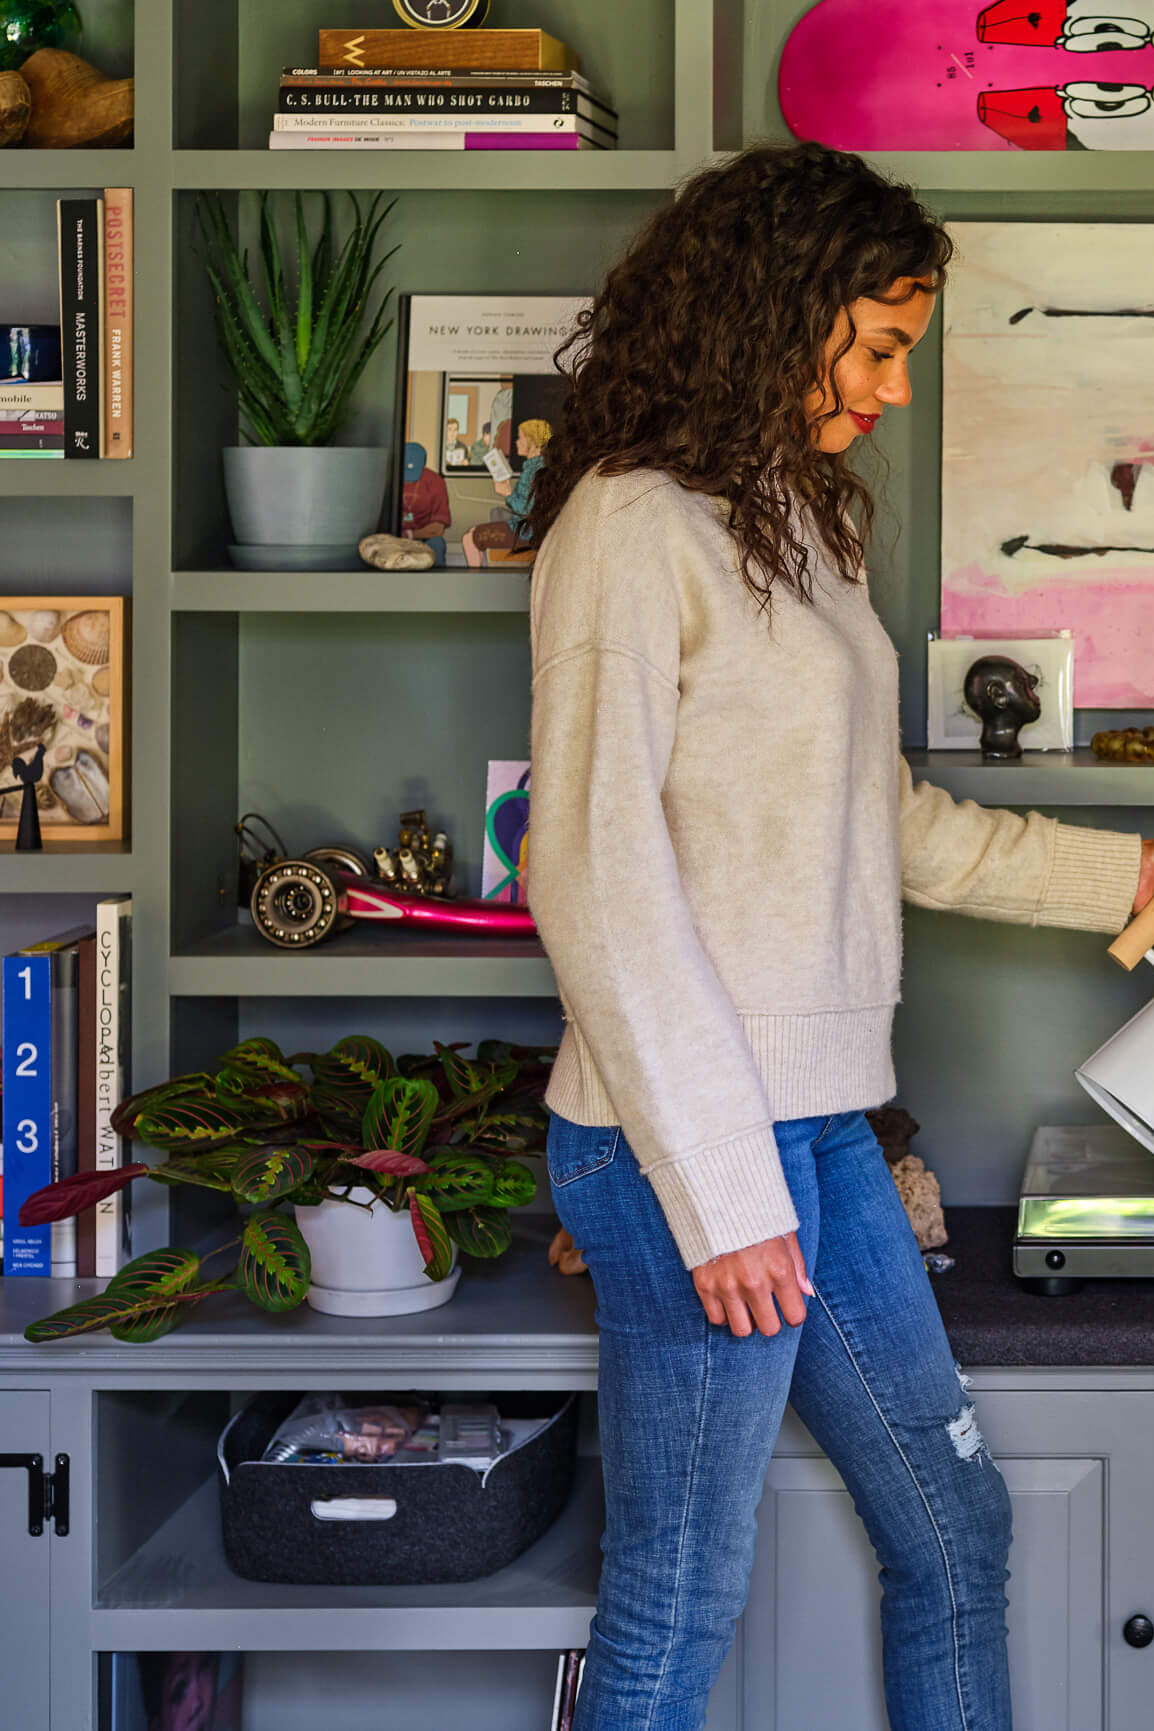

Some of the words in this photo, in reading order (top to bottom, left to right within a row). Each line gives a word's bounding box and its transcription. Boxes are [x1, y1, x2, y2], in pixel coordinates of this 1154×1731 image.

[286, 94, 297, 106] C.
[300, 94, 312, 106] S.
[384, 94, 412, 106] MAN
[416, 94, 445, 106] WHO
[449, 94, 483, 106] SHOT
[488, 95, 530, 107] GARBO
[294, 118, 328, 127] Modern
[107, 206, 126, 319] POSTSECRET
[112, 329, 121, 367] FRANK
[429, 326, 460, 337] NEW
[467, 326, 499, 337] YORK
[75, 312, 87, 401] MASTERWORKS
[112, 371, 122, 418] WARREN
[18, 966, 32, 1000] 1
[16, 1042, 38, 1077] 2
[16, 1119, 39, 1154] 3
[99, 1127, 115, 1213] WATN
